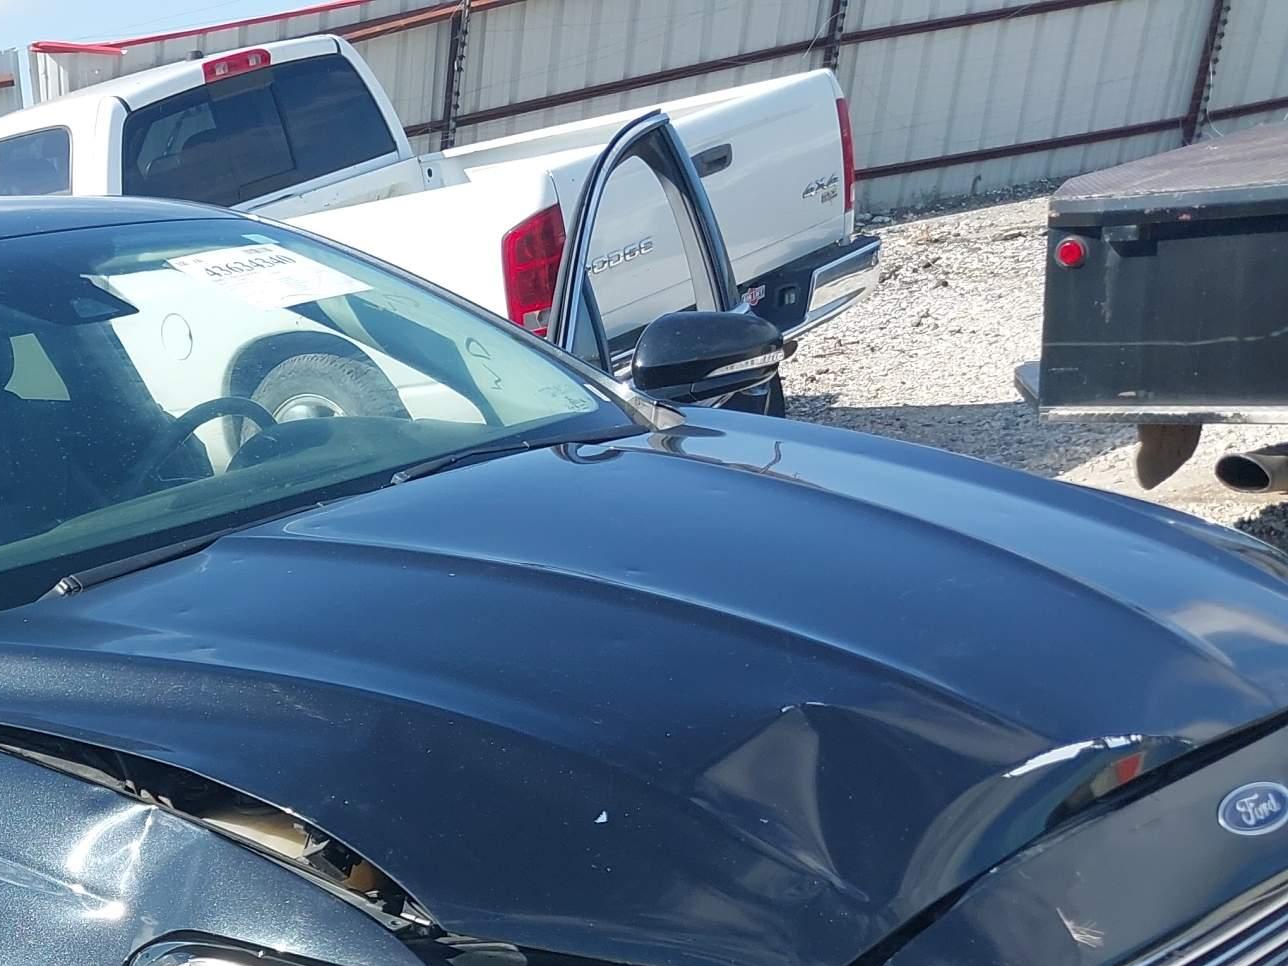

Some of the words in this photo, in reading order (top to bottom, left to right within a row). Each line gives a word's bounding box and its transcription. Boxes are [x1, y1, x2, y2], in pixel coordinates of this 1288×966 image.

[203, 253, 298, 280] 43634340
[584, 235, 655, 275] ODGE
[1235, 792, 1282, 826] Ford
